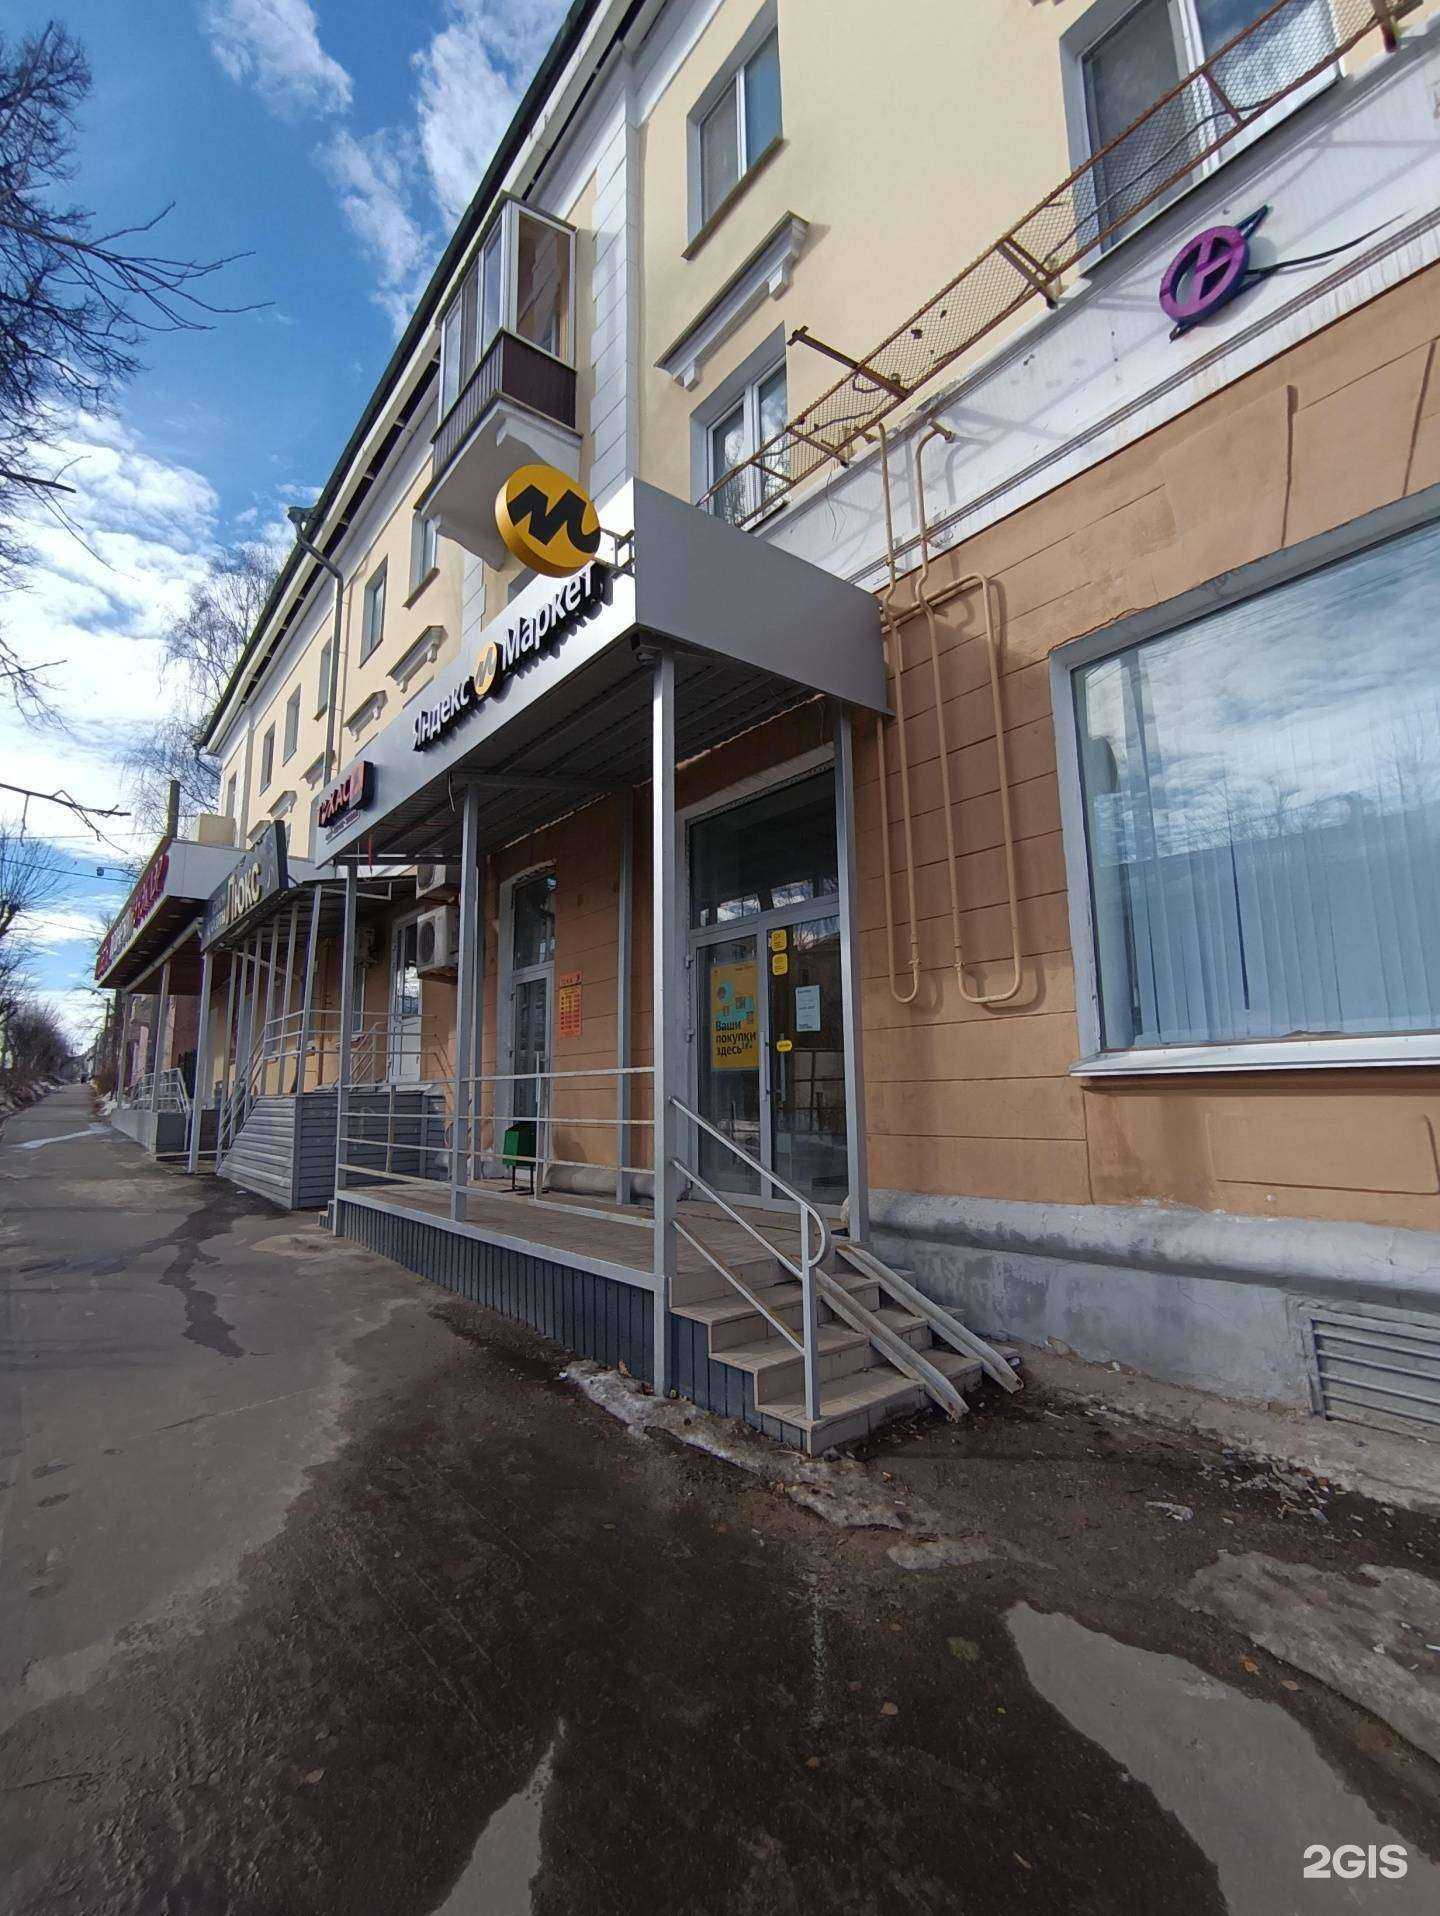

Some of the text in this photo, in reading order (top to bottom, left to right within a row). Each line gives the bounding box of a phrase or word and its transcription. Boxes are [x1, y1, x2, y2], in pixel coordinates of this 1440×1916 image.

[412, 560, 600, 748] Яндекс Маркет
[715, 1020, 742, 1032] Ваши
[715, 1031, 757, 1045] покупки
